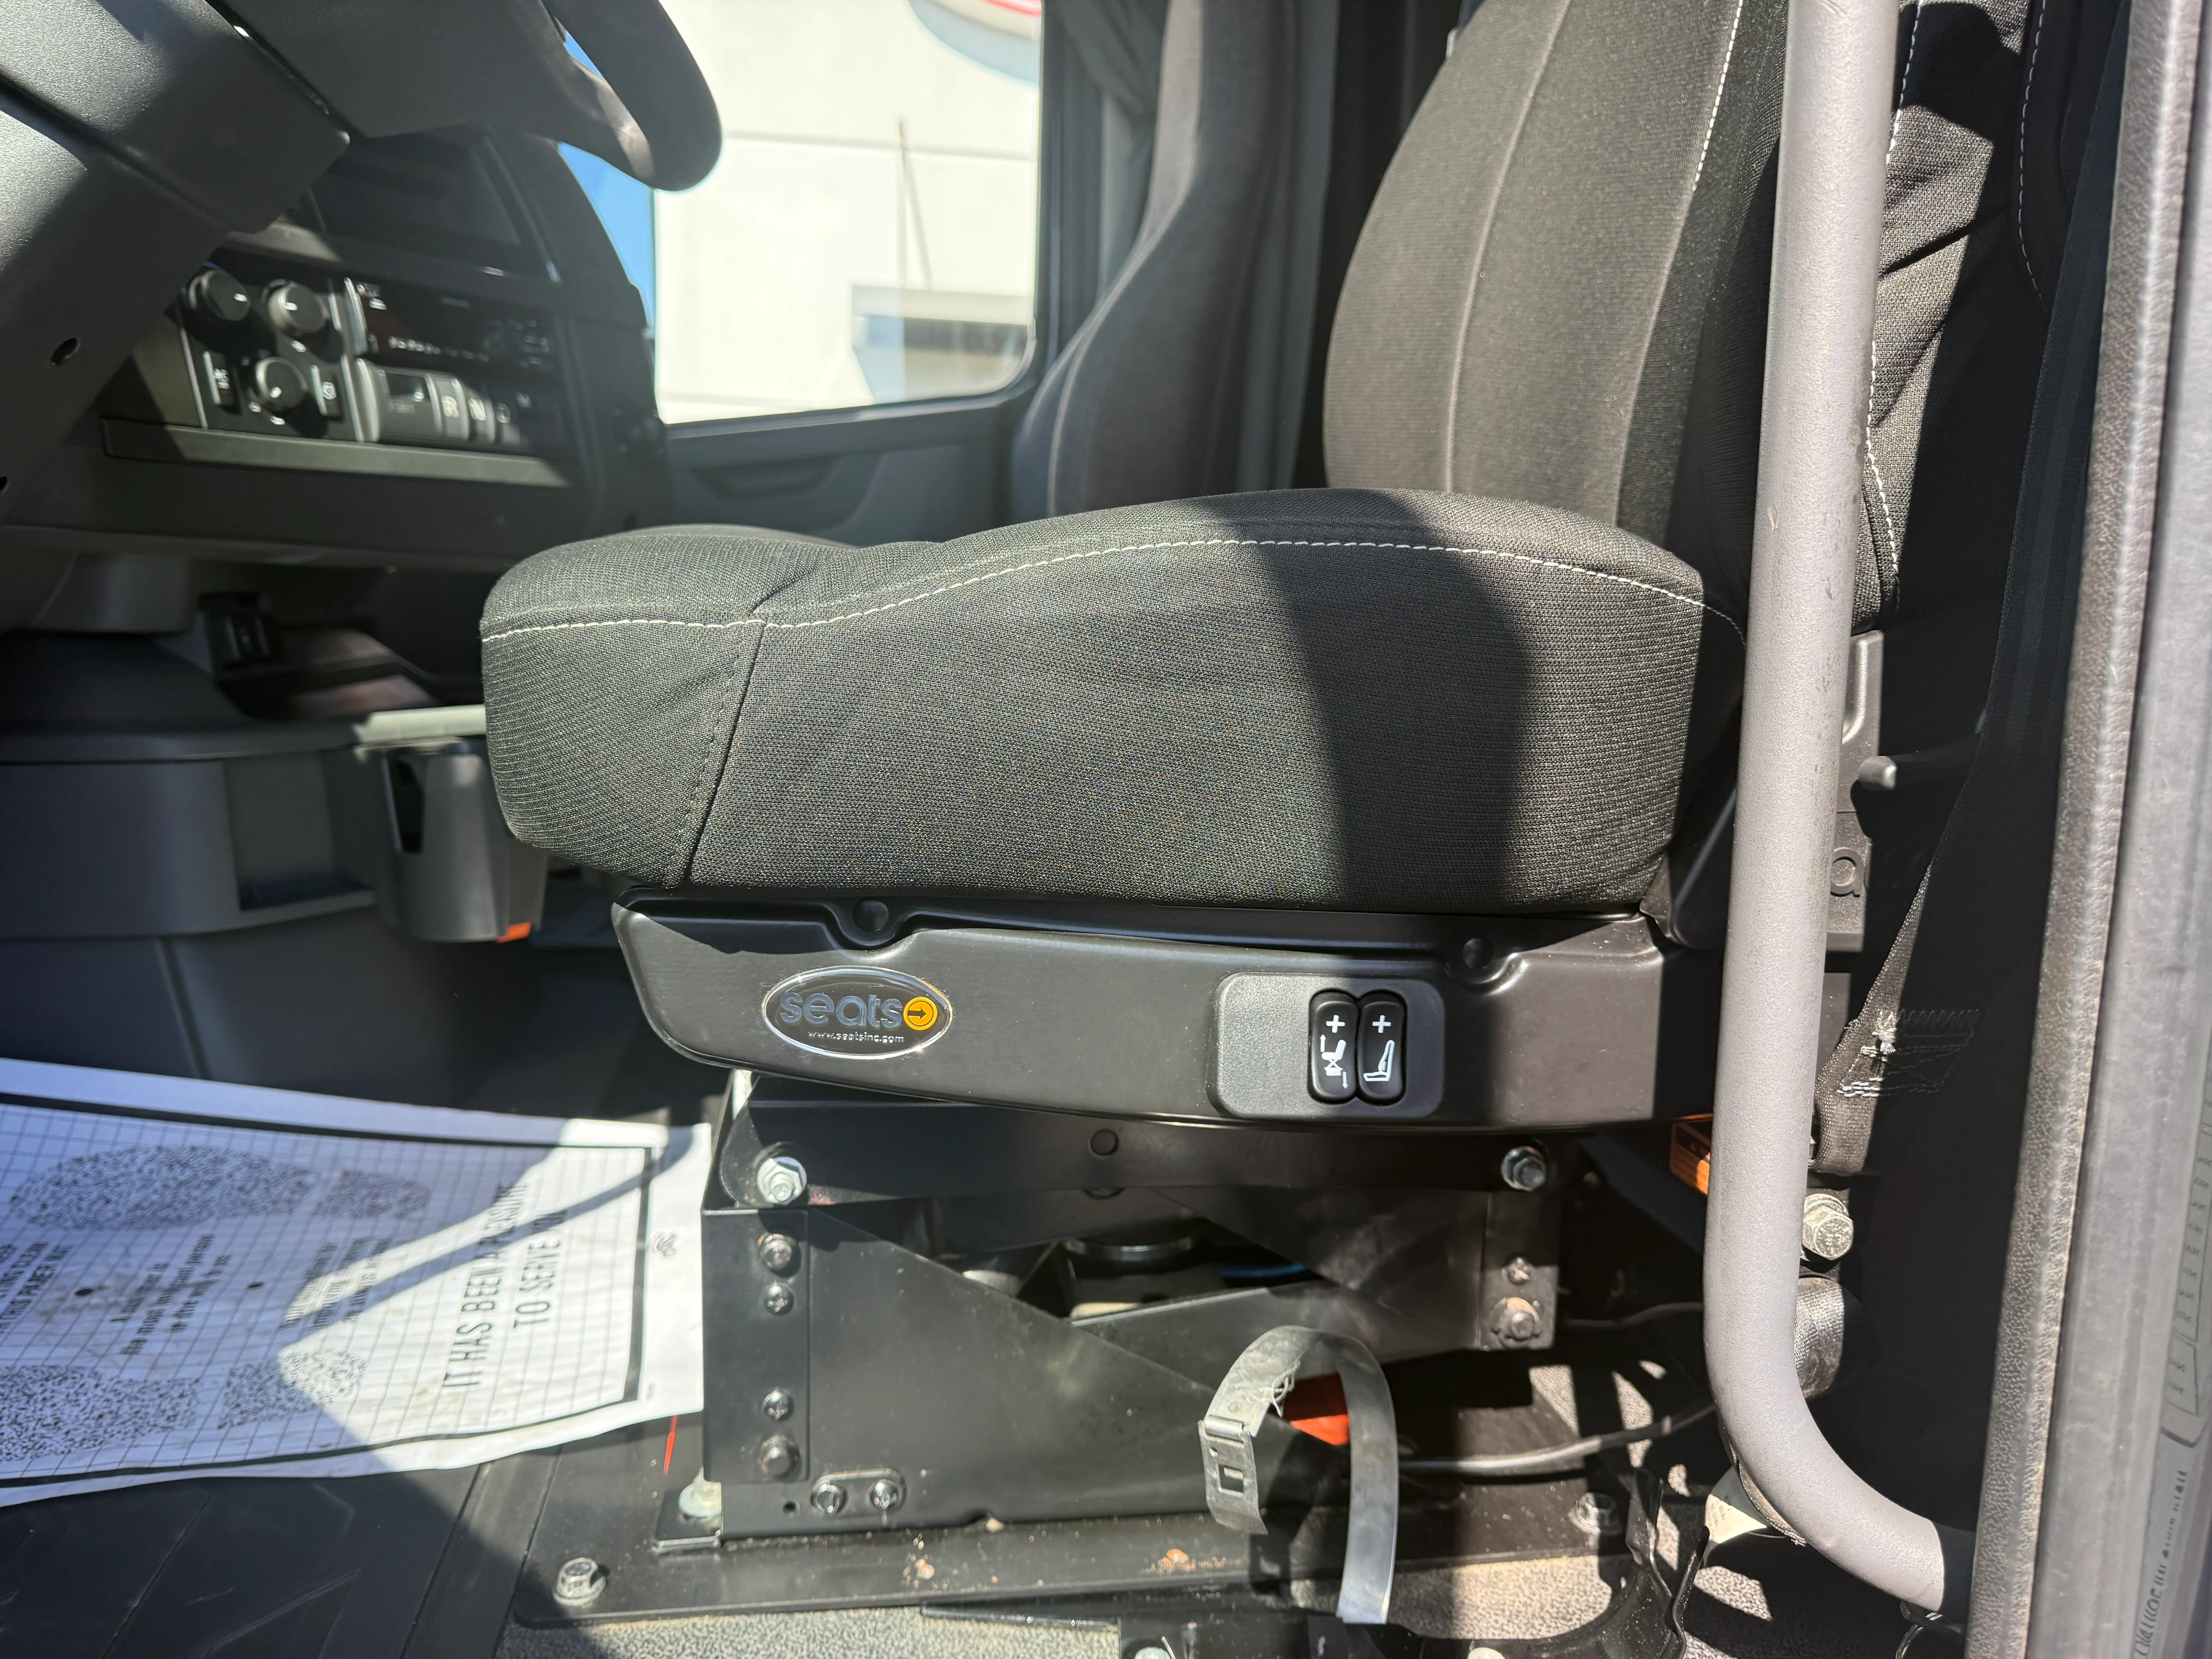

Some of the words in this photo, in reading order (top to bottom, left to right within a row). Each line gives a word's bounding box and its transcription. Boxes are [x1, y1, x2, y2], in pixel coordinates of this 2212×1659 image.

[780, 992, 903, 1028] seats
[808, 1031, 904, 1043] www.seatsinc.com
[518, 1238, 562, 1293] SERVE
[460, 1265, 503, 1312] BEEN
[512, 1300, 551, 1330] TO
[449, 1322, 493, 1362] HAS
[441, 1371, 483, 1389] IT
